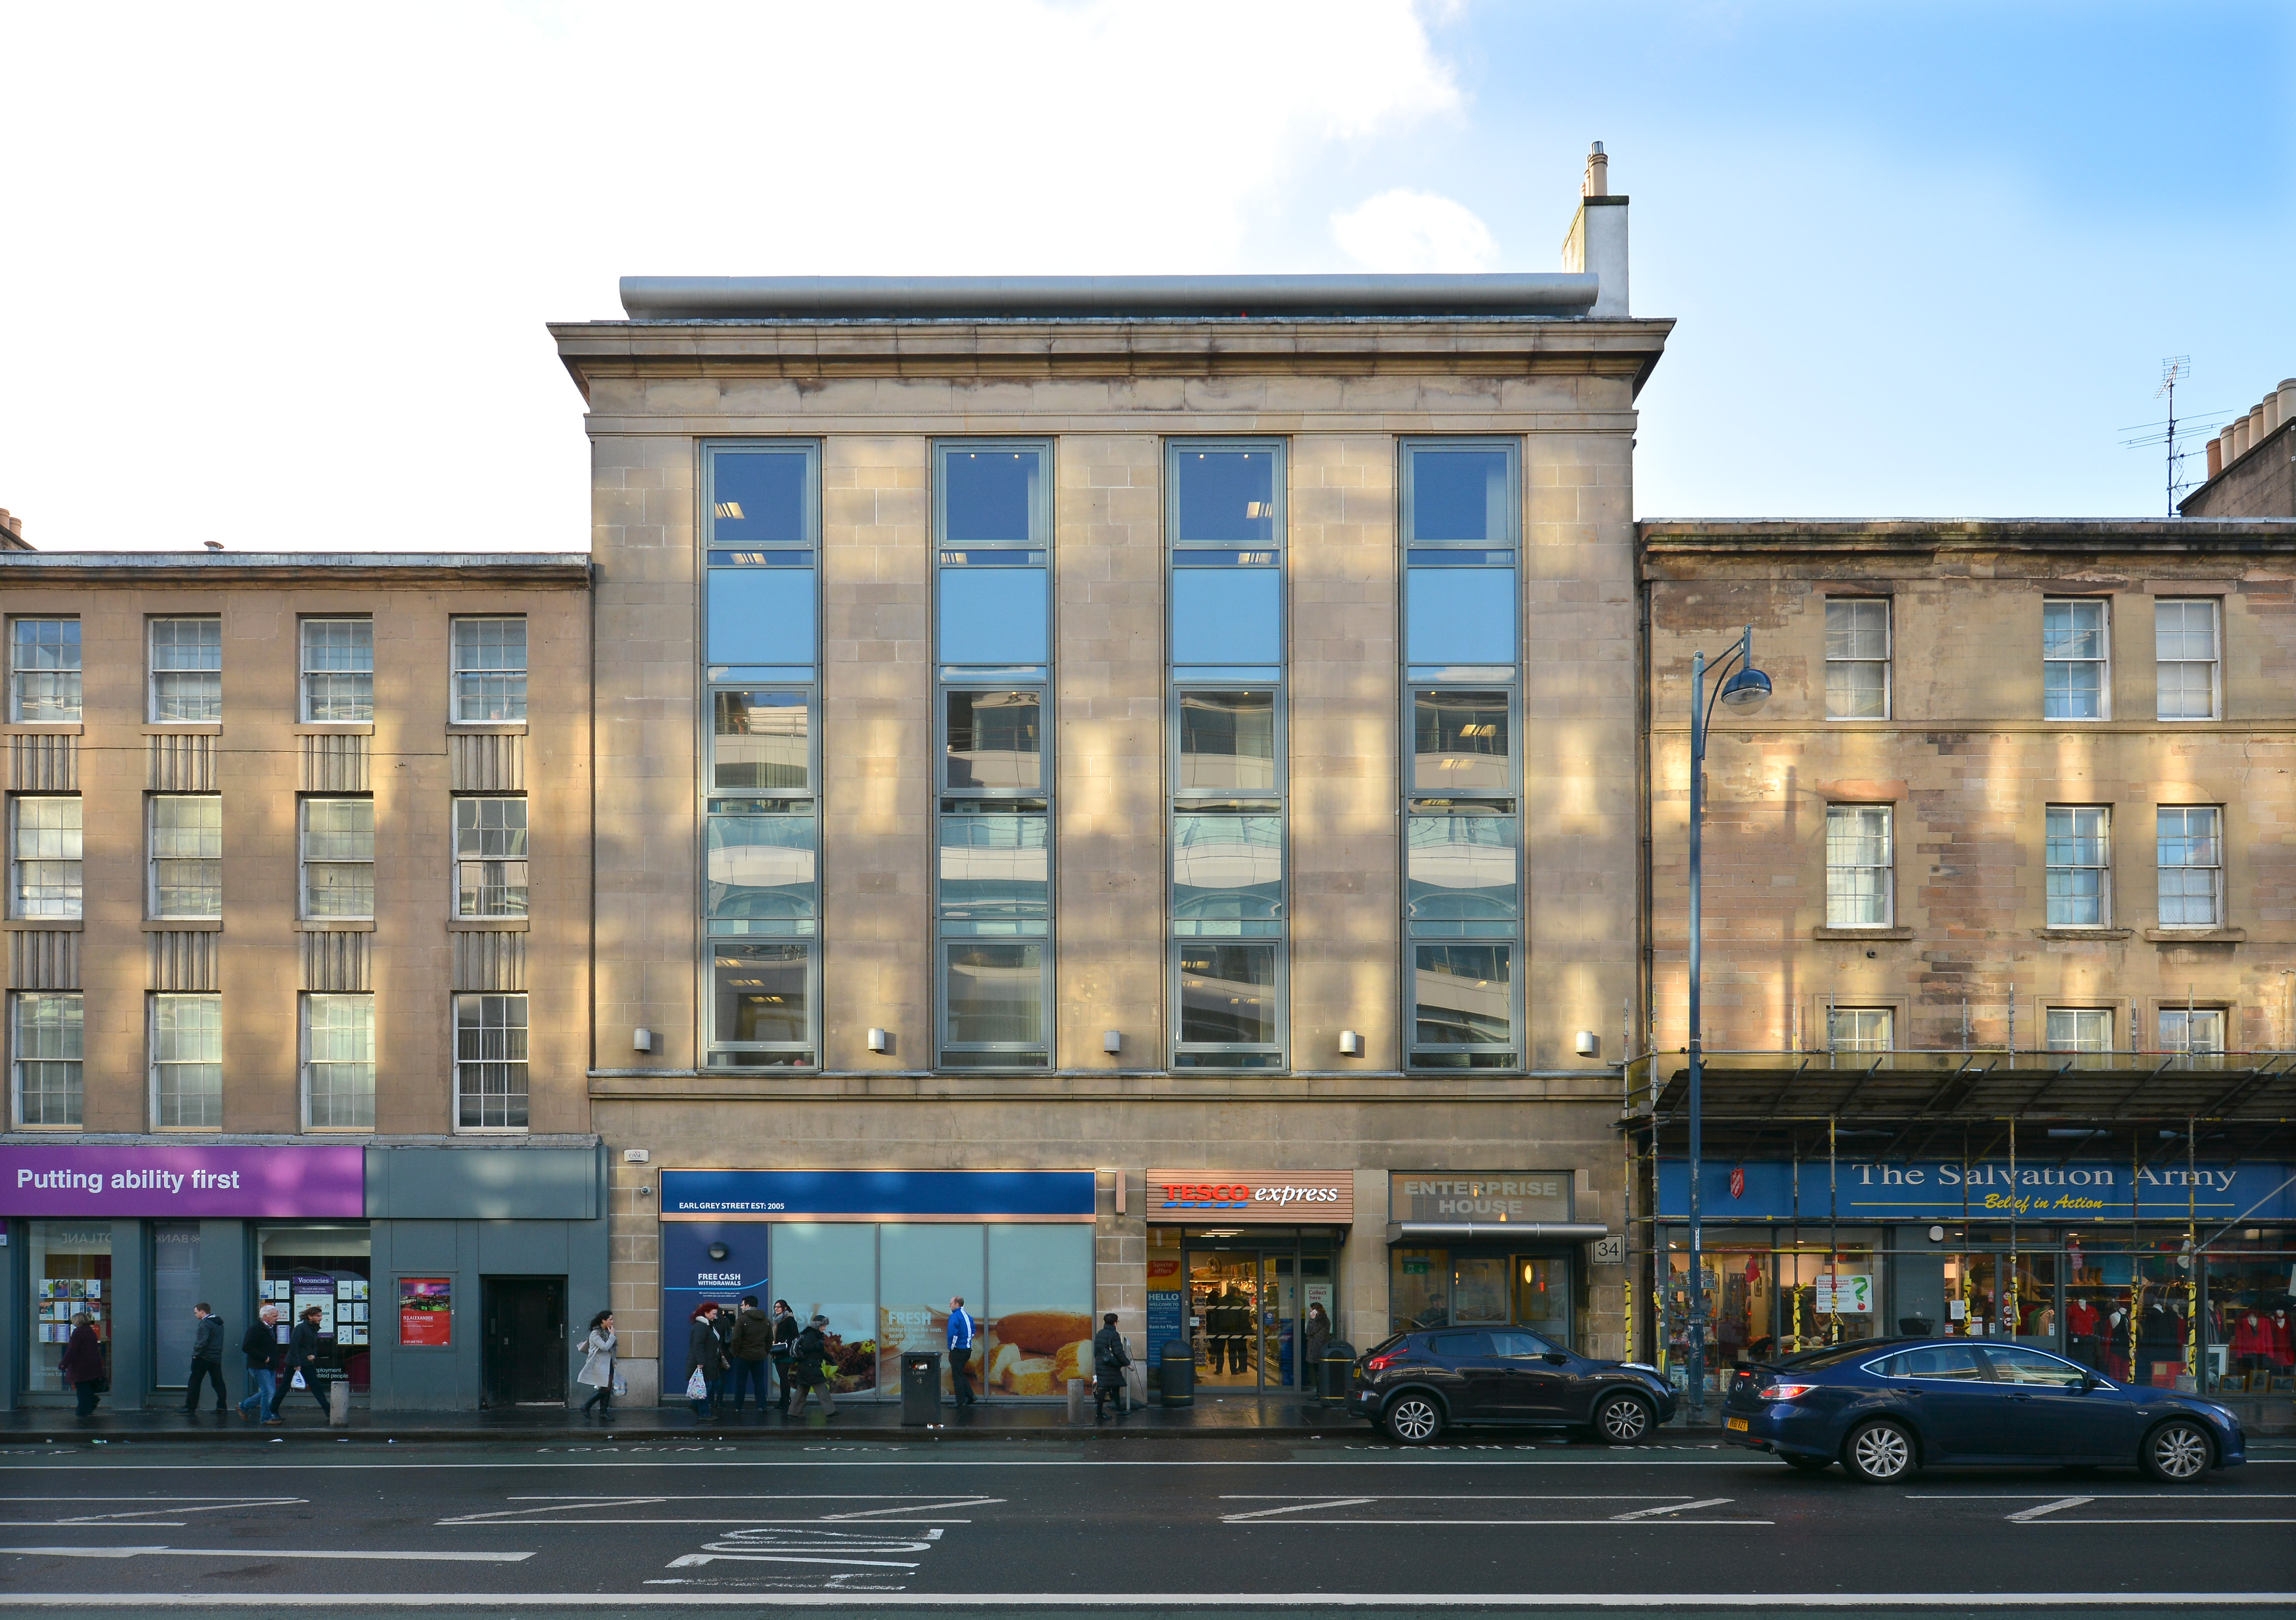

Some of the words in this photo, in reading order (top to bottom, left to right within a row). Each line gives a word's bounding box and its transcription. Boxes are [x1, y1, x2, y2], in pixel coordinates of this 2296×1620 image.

[17, 1169, 102, 1193] Putting
[111, 1169, 184, 1193] ability
[192, 1169, 240, 1189] first
[1853, 1164, 1925, 1185] The
[1939, 1164, 2115, 1185] Salvation
[2129, 1165, 2237, 1192] Army
[1162, 1184, 1249, 1200] TESCO
[1255, 1185, 1338, 1206] express
[1404, 1181, 1557, 1196] ENTERPRISE
[1439, 1200, 1523, 1214] HOUSE
[1985, 1193, 2030, 1213] Belef
[2034, 1197, 2049, 1209] in
[2053, 1194, 2103, 1209] Action
[1598, 1242, 1619, 1256] 34
[889, 1311, 931, 1325] FRESH
